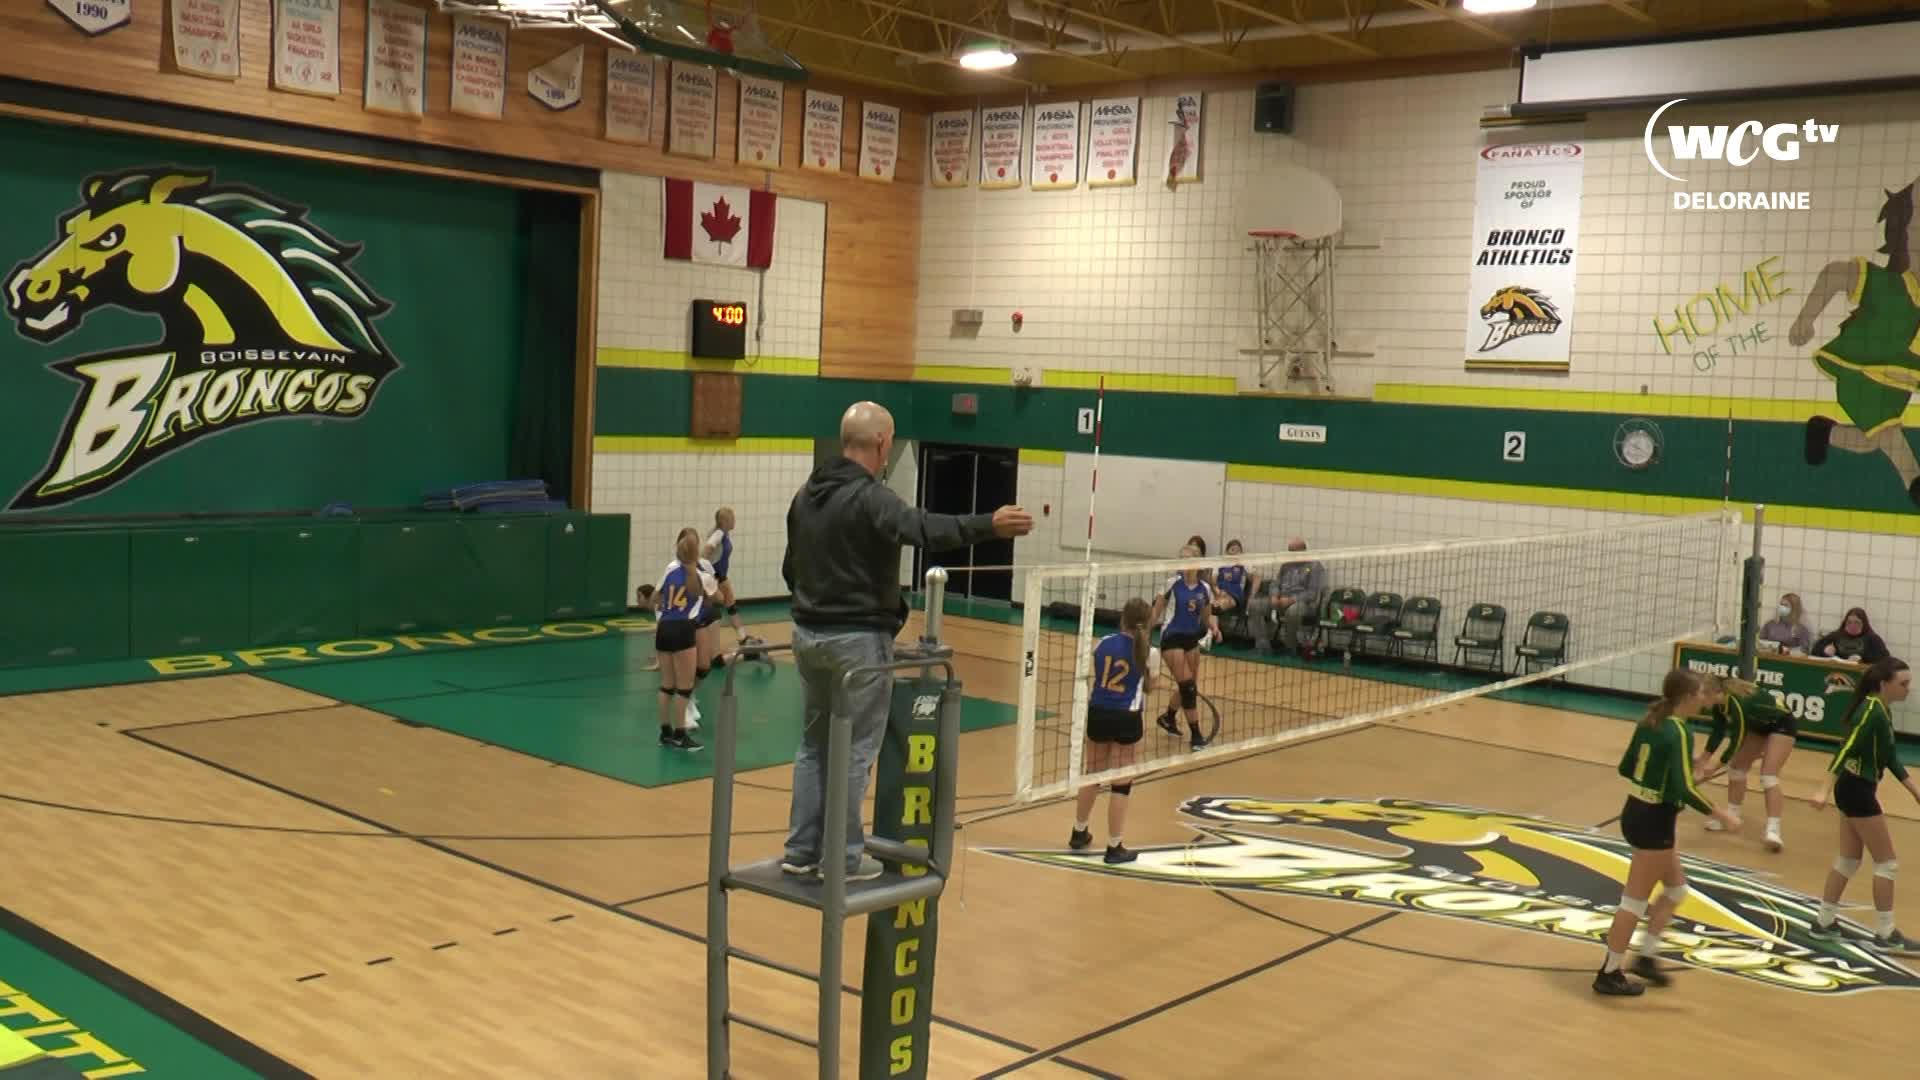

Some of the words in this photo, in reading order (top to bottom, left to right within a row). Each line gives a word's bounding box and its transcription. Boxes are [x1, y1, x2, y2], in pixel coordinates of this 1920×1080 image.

[75, 1, 108, 20] 1990
[287, 45, 325, 60] FINALISTS
[984, 111, 1021, 122] MHSAA
[1037, 109, 1075, 121] MHSAA
[1094, 103, 1133, 117] MHSAA
[1491, 147, 1572, 159] FANATICS
[1511, 180, 1547, 190] PROUD
[1504, 190, 1552, 200] SPONSOR
[1520, 200, 1534, 209] OF
[1487, 228, 1565, 247] BRONCO
[1476, 248, 1574, 266] ATHLETICS
[1653, 255, 1793, 356] HOME
[1479, 321, 1557, 352] BRONCOS
[1693, 347, 1722, 373] OF
[1726, 321, 1771, 357] THE
[201, 349, 347, 365] BOISSEVAIN
[36, 351, 376, 497] BRONCOS
[1083, 411, 1092, 430] 1
[1286, 427, 1323, 440] GUESTS
[1507, 435, 1522, 458] 2
[668, 584, 688, 612] 14
[145, 617, 657, 675] BRONCOS
[1101, 655, 1130, 694] 12
[1688, 659, 1729, 678] HOME
[1633, 743, 1651, 782] 1
